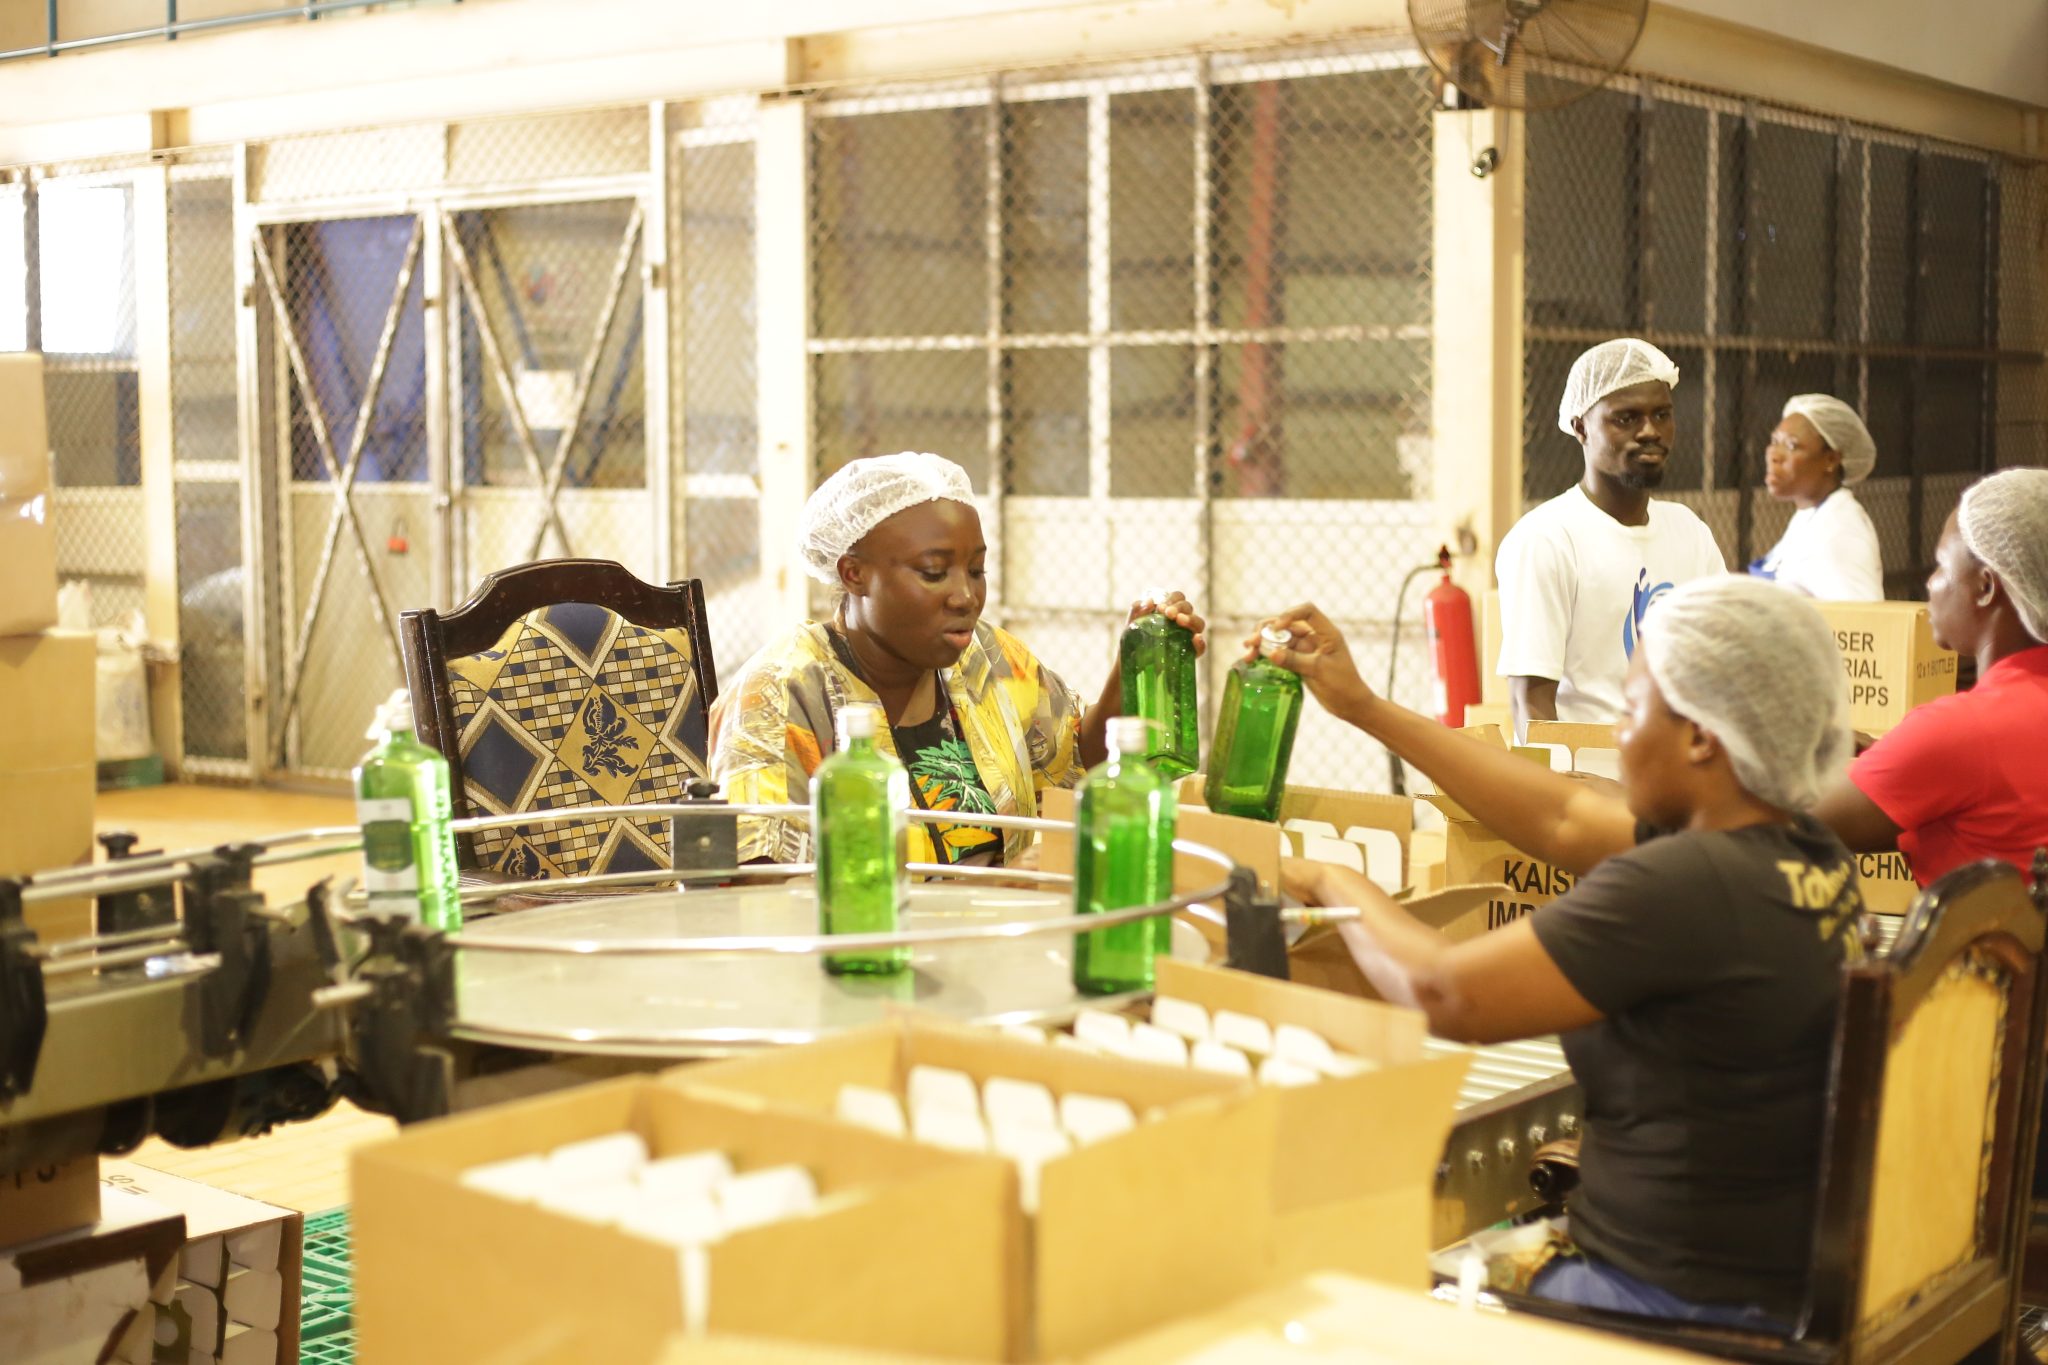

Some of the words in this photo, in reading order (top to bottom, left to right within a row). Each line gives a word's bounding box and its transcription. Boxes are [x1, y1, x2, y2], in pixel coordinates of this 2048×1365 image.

[1843, 658, 1883, 679] RIAL
[1849, 685, 1889, 707] PPS
[1856, 854, 1914, 882] CHN
